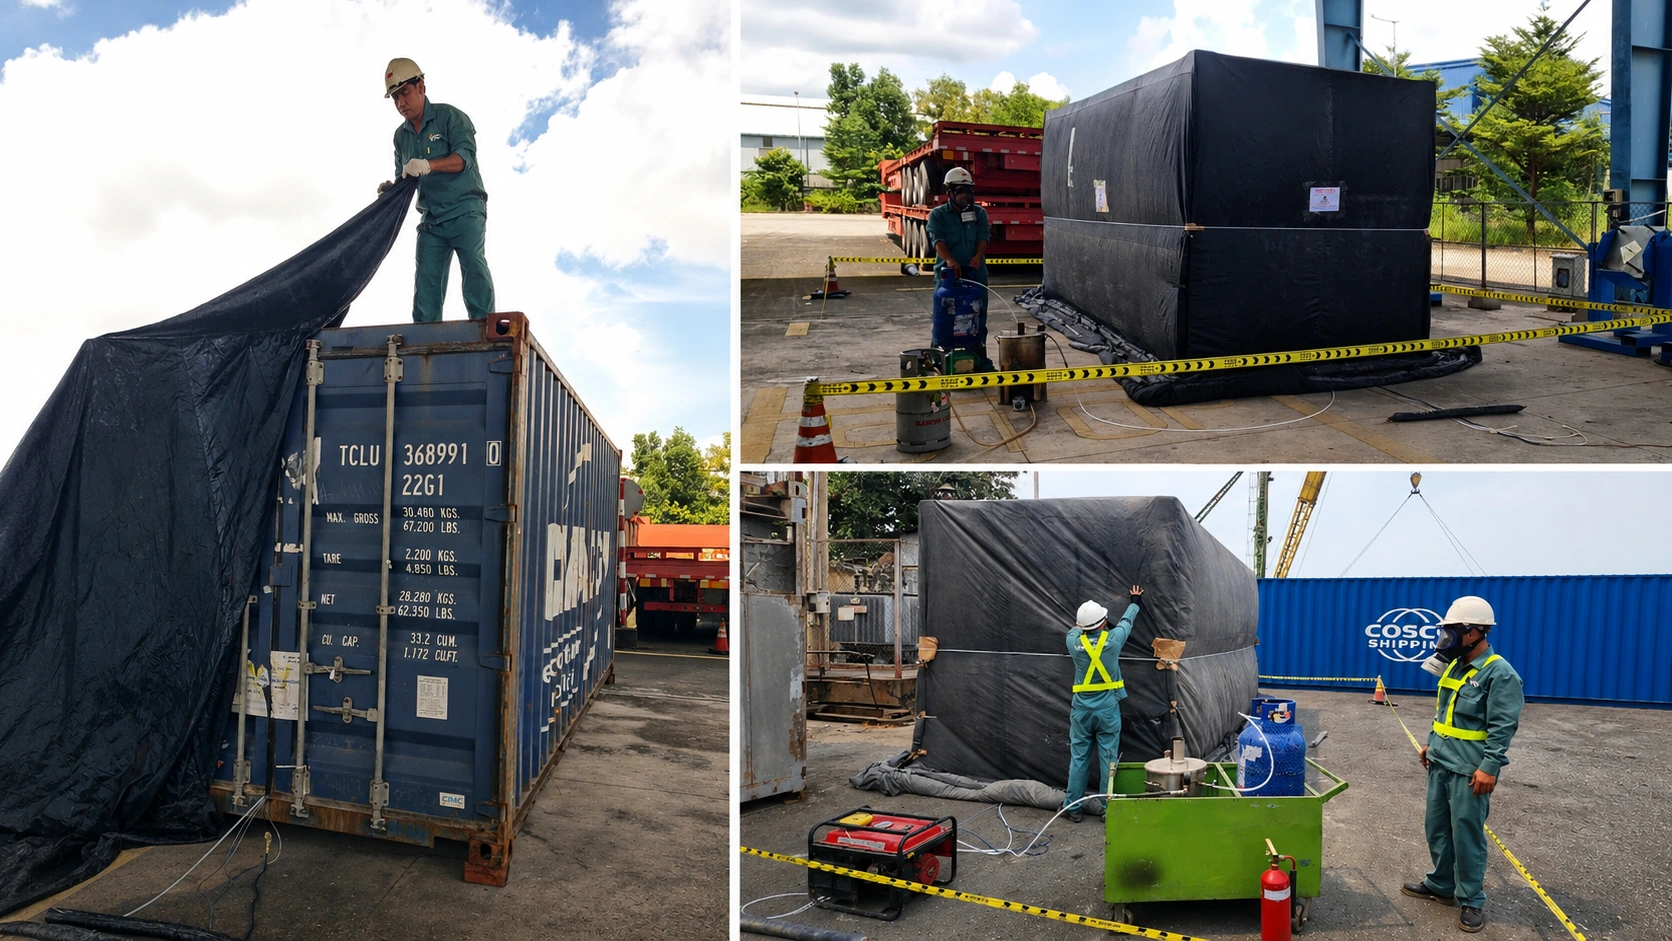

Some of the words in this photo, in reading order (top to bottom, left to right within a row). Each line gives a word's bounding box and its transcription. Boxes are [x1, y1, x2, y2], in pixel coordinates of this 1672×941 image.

[339, 444, 380, 466] TCLU
[403, 442, 467, 466] 368991
[488, 442, 500, 465] 0
[402, 473, 444, 496] 22G1
[326, 512, 346, 523] MAX.
[353, 512, 379, 524] GROSS
[402, 506, 434, 518] 30.480
[440, 507, 460, 519] KGS.
[403, 520, 434, 533] 67.200
[440, 521, 460, 534] LBS.
[322, 552, 342, 564] TARE
[405, 548, 431, 561] 2.200
[437, 549, 458, 563] KGS.
[405, 563, 432, 575] 4.850
[438, 564, 458, 576] LBS.
[320, 593, 336, 605] NET
[398, 590, 431, 603] 28.280
[436, 592, 457, 605] KGS.
[397, 604, 430, 618] 62.350
[435, 607, 456, 620] LBS.
[1364, 623, 1441, 640] COSC
[321, 634, 333, 646] CU.
[341, 635, 360, 648] CAP.
[410, 632, 431, 646] 33.2
[436, 634, 458, 648] CUM.
[1368, 638, 1438, 650] SHIPPIN
[403, 646, 429, 660] 1.172
